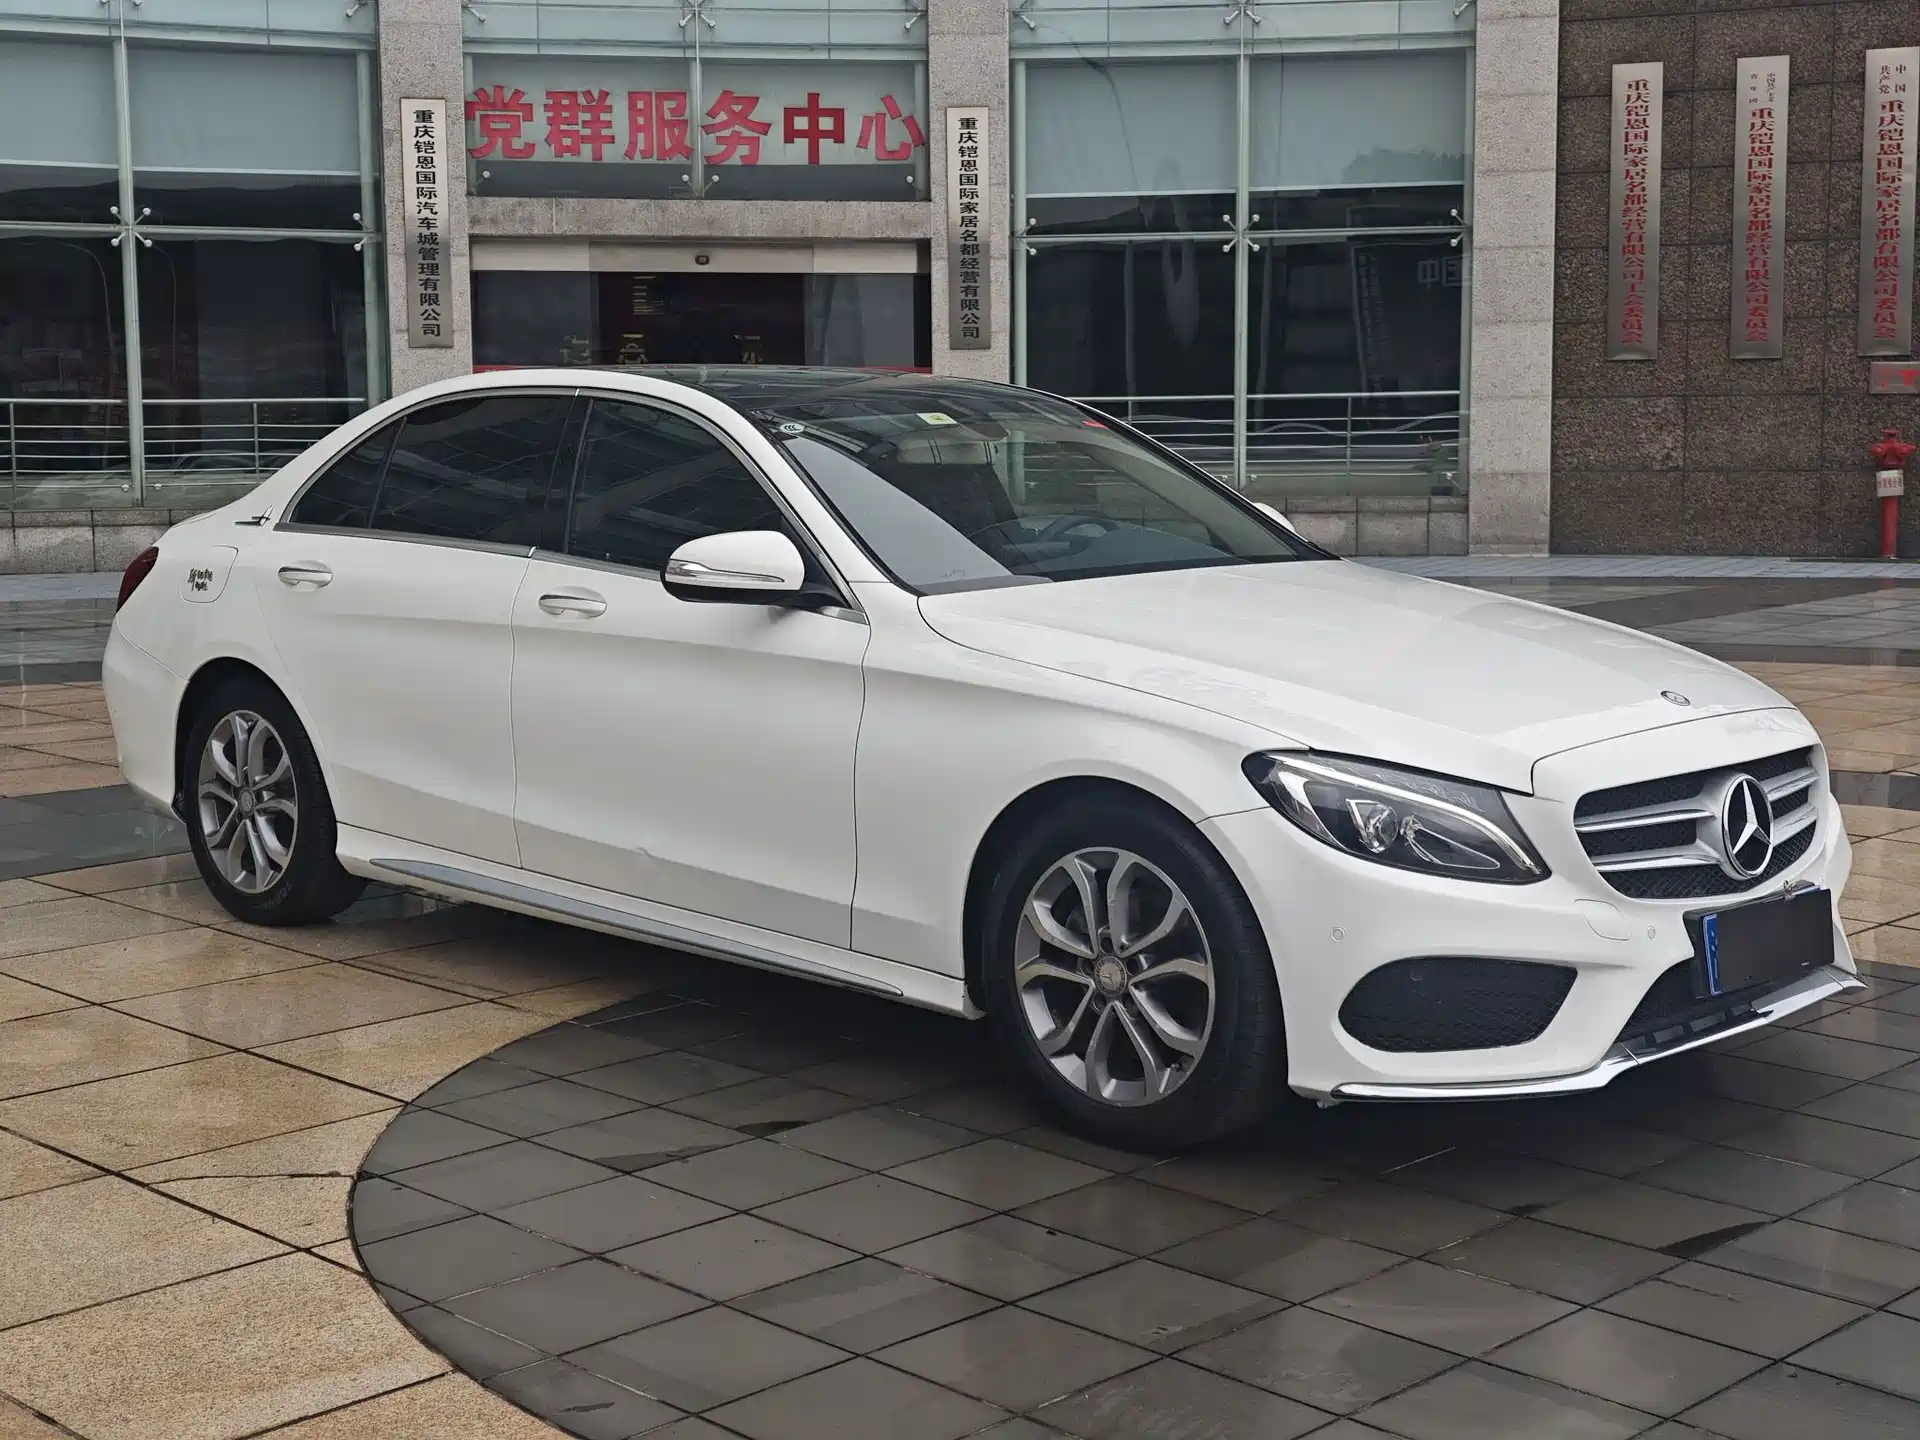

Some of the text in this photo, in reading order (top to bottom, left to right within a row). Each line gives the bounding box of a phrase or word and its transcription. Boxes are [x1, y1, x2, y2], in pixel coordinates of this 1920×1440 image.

[413, 109, 442, 337] 重庆铠恩国际汽车城管理有限公司
[465, 85, 925, 168] 党群服务中心
[957, 117, 981, 339] 重庆铠恩国际家居名都经营有限公司
